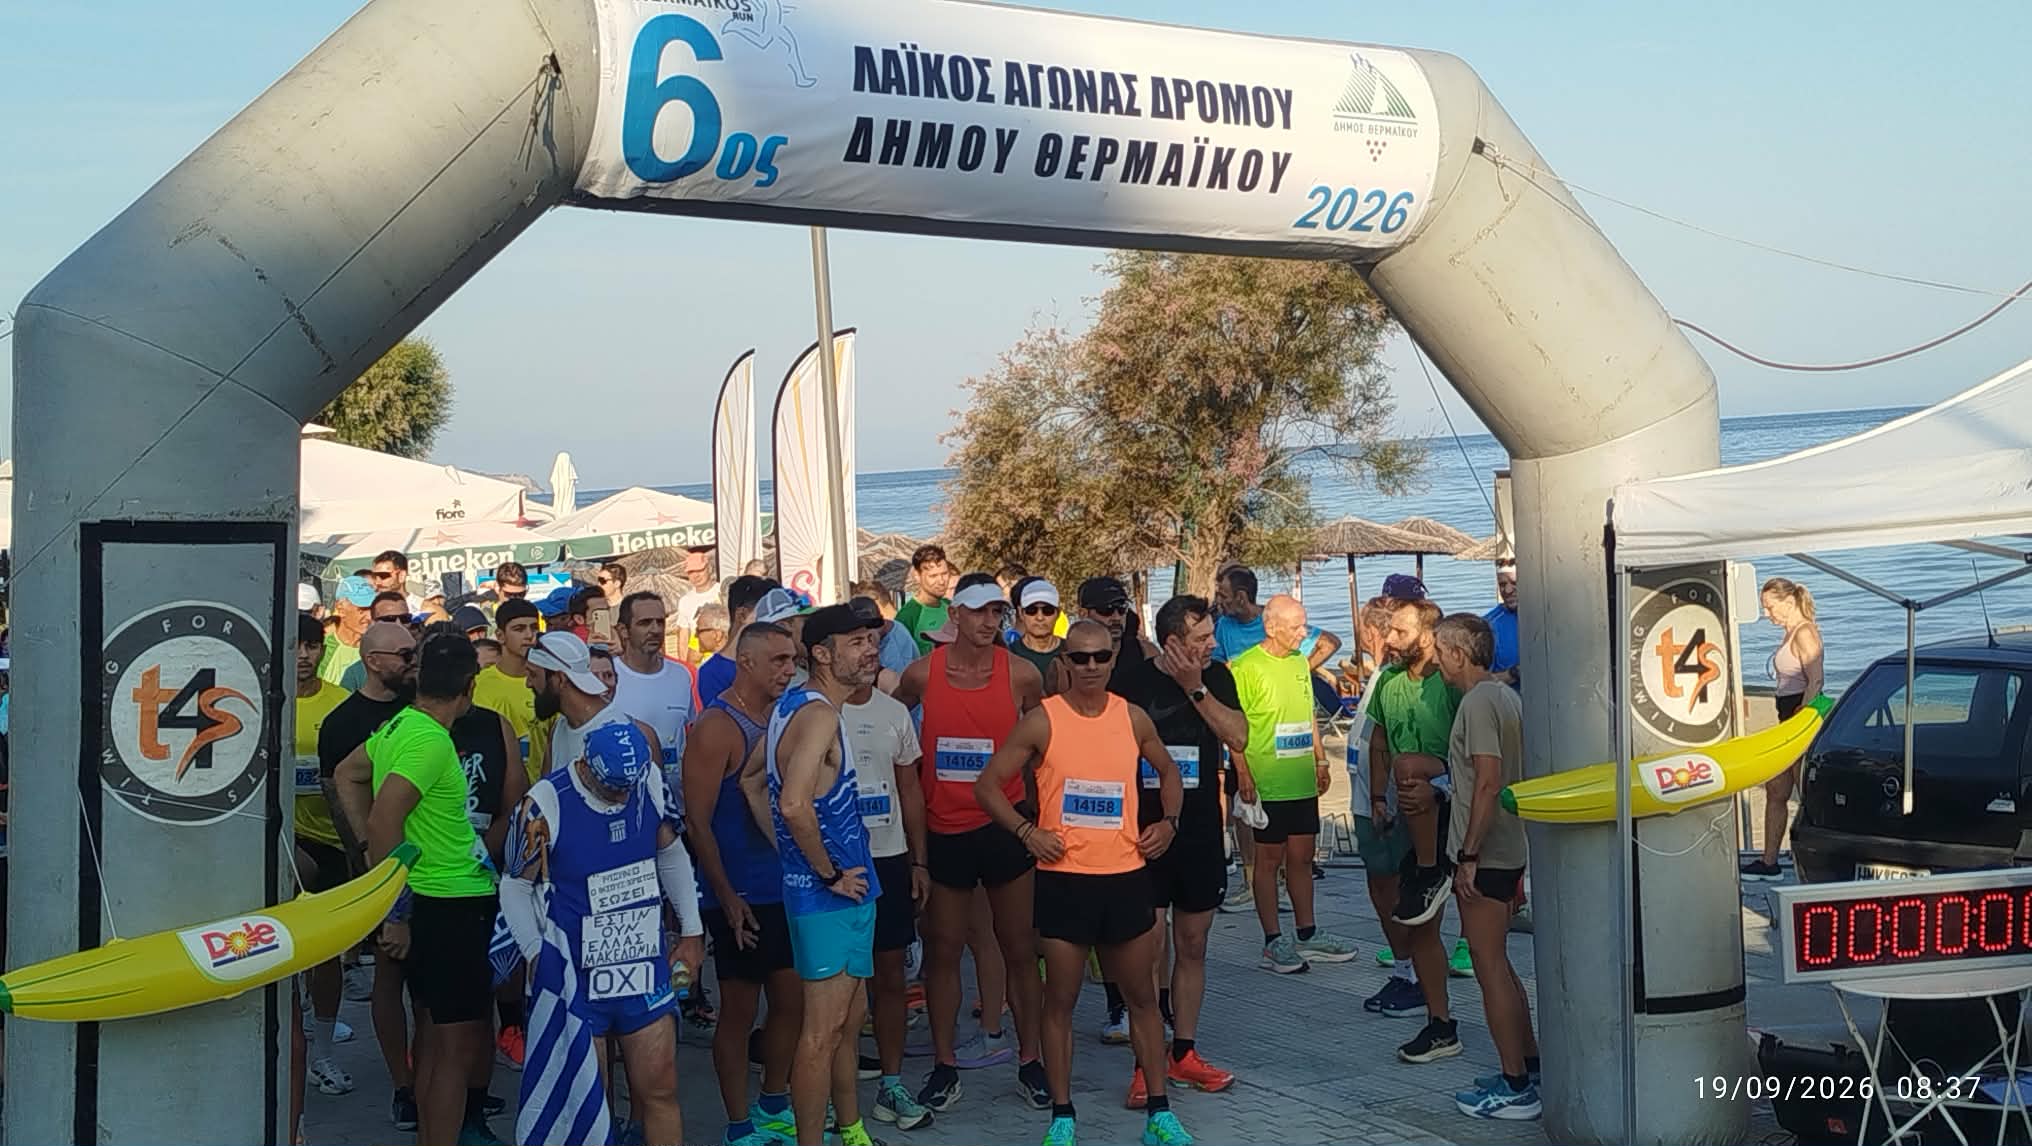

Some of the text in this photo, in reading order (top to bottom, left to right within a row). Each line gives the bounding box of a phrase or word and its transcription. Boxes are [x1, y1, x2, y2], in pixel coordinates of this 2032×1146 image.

[853, 43, 1293, 130] ΛΑΪΚΟΣ ΑΓΩΝΑΣ ΔΡΟΜΟΥ
[843, 117, 1293, 194] ΔΗΜΟΥ ΘΕΡΜΑΪΚΟΥ
[1293, 185, 1414, 234] 2026
[436, 508, 465, 520] fiore
[408, 549, 515, 575] eineken
[161, 615, 233, 634] FOR
[1656, 760, 1713, 789] Dole
[1072, 798, 1115, 813] 14158
[598, 886, 645, 908] ΣΩΖΕΙ
[594, 908, 652, 928] ΕΣΤΙΝ
[601, 921, 639, 938] ΟΥΝ
[202, 921, 277, 960] Dole
[593, 963, 650, 995] ΟΧΙ
